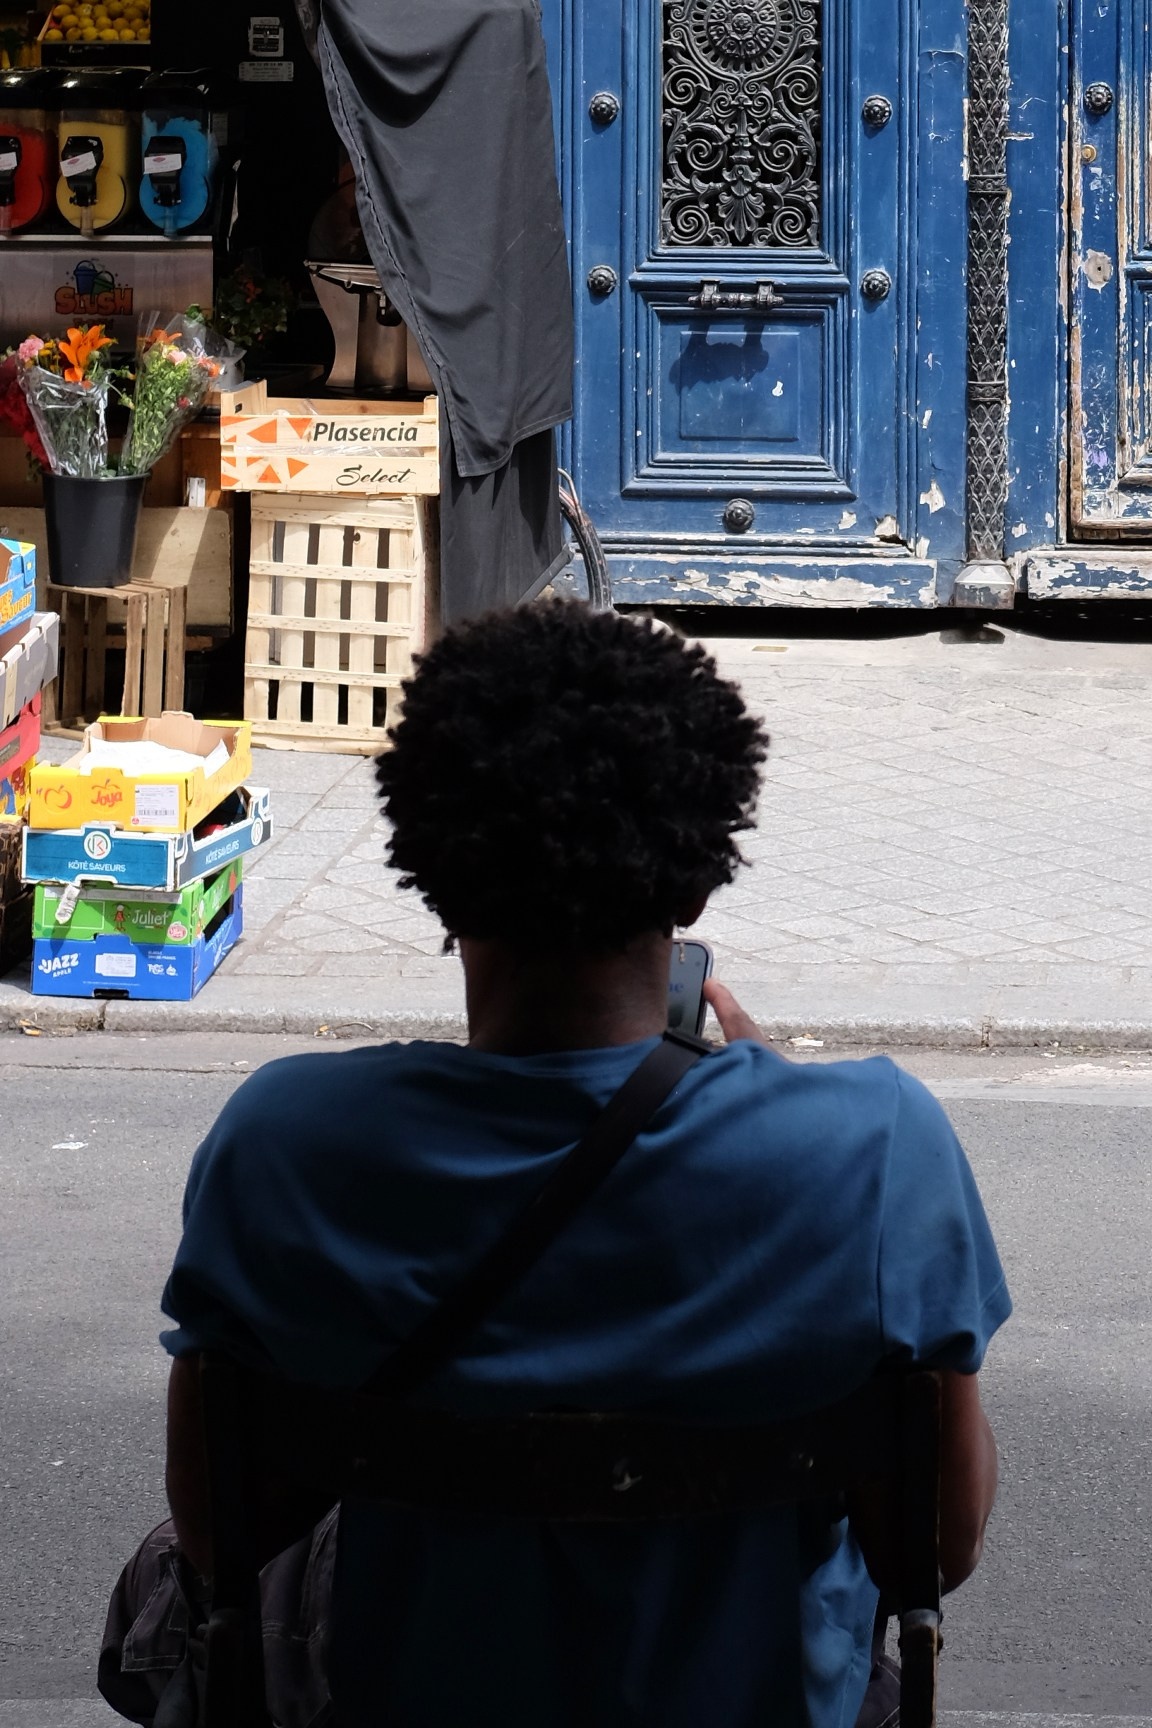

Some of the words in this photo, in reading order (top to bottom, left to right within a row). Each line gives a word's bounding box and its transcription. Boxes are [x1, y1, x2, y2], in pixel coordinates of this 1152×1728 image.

[55, 285, 133, 316] SLUSH
[313, 422, 418, 442] Plasencia
[335, 464, 417, 486] Select
[91, 790, 123, 808] Joya
[89, 862, 126, 873] SAVEURS
[132, 909, 169, 925] Juliet
[38, 953, 79, 974] JAZZ
